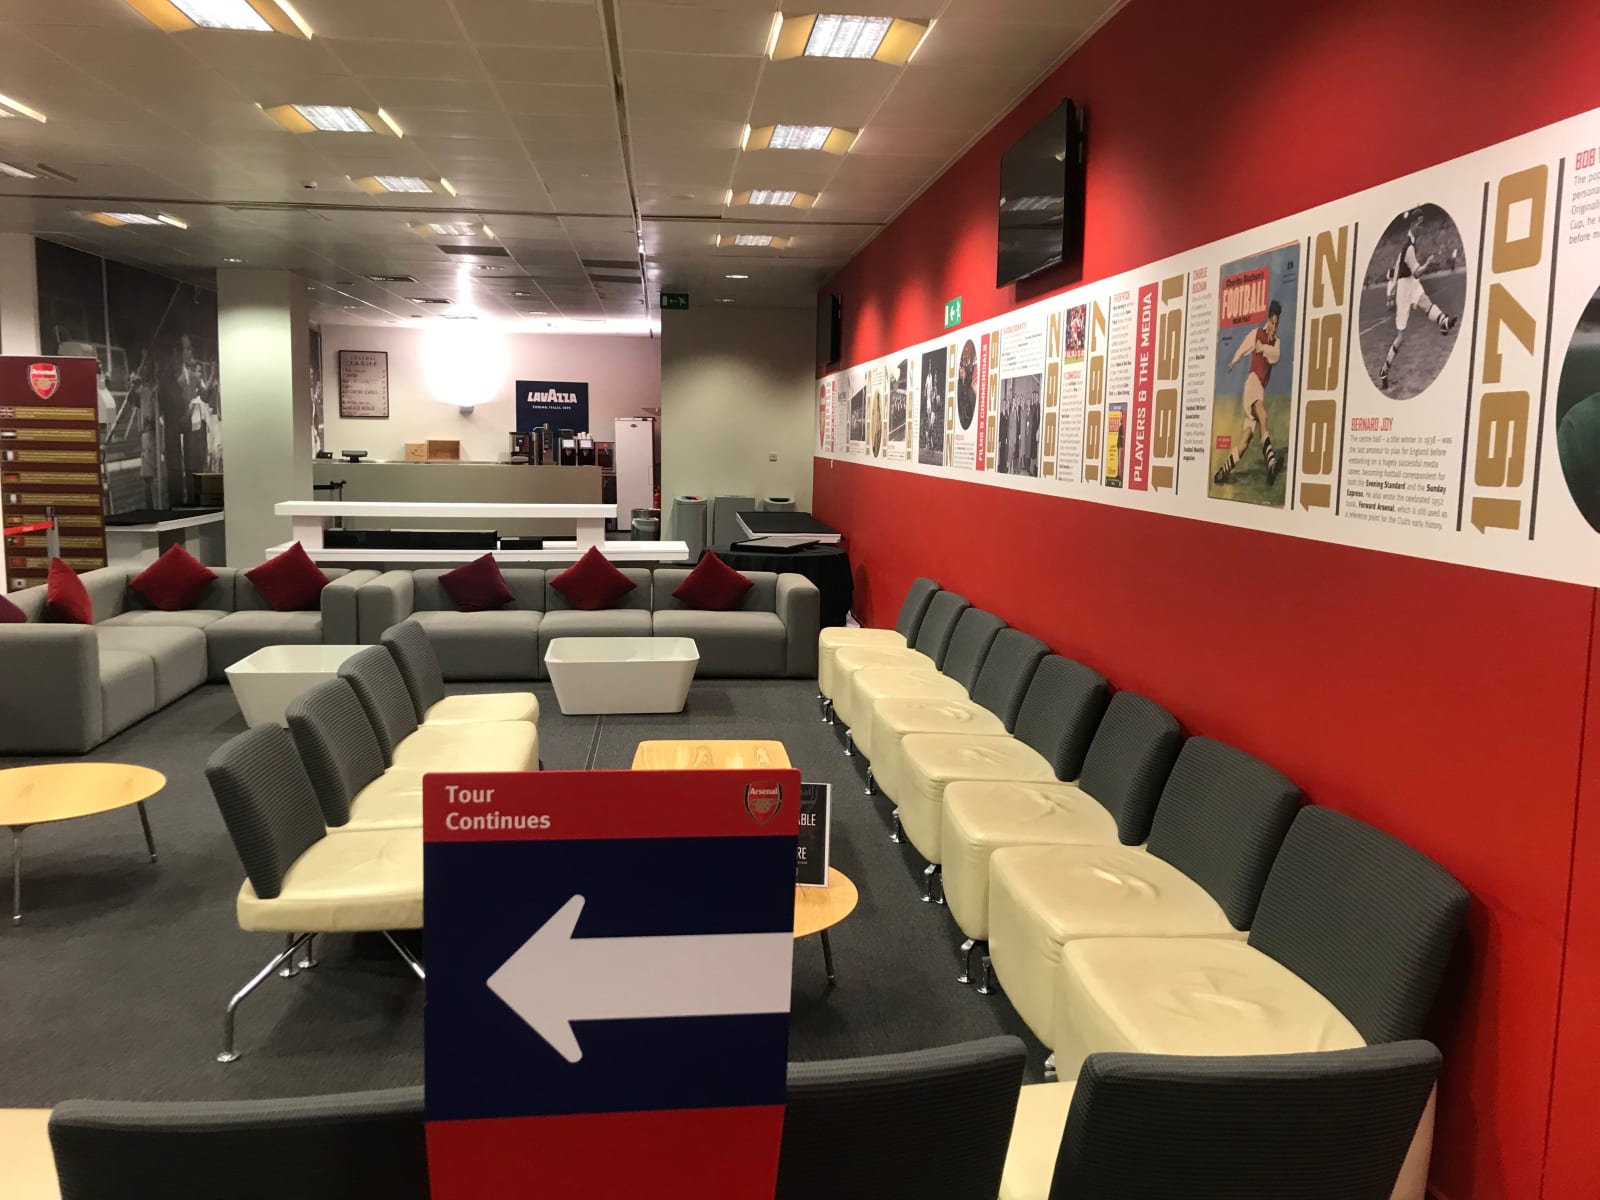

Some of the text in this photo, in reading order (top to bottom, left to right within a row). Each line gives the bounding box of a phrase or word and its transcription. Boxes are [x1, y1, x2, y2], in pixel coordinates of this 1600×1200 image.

[1576, 148, 1596, 170] BOB
[1574, 175, 1586, 185] The
[1587, 216, 1596, 225] he
[1568, 232, 1590, 245] before
[1222, 280, 1266, 320] FOOTBALL
[1471, 164, 1549, 535] 1970
[1300, 225, 1348, 512] 1952
[1134, 292, 1152, 482] PLAYERS & THE MEDIA
[1152, 274, 1184, 493] 1951
[528, 388, 578, 404] LAVAZZA
[1351, 417, 1393, 431] BERNARD JOY
[1410, 448, 1428, 456] England
[1430, 448, 1446, 456] before
[1366, 480, 1383, 490] Evening
[1384, 481, 1405, 489] Standard
[1426, 484, 1447, 495] Sunday
[1359, 501, 1376, 509] Forward
[445, 786, 495, 803] Tour
[446, 810, 551, 830] Continues
